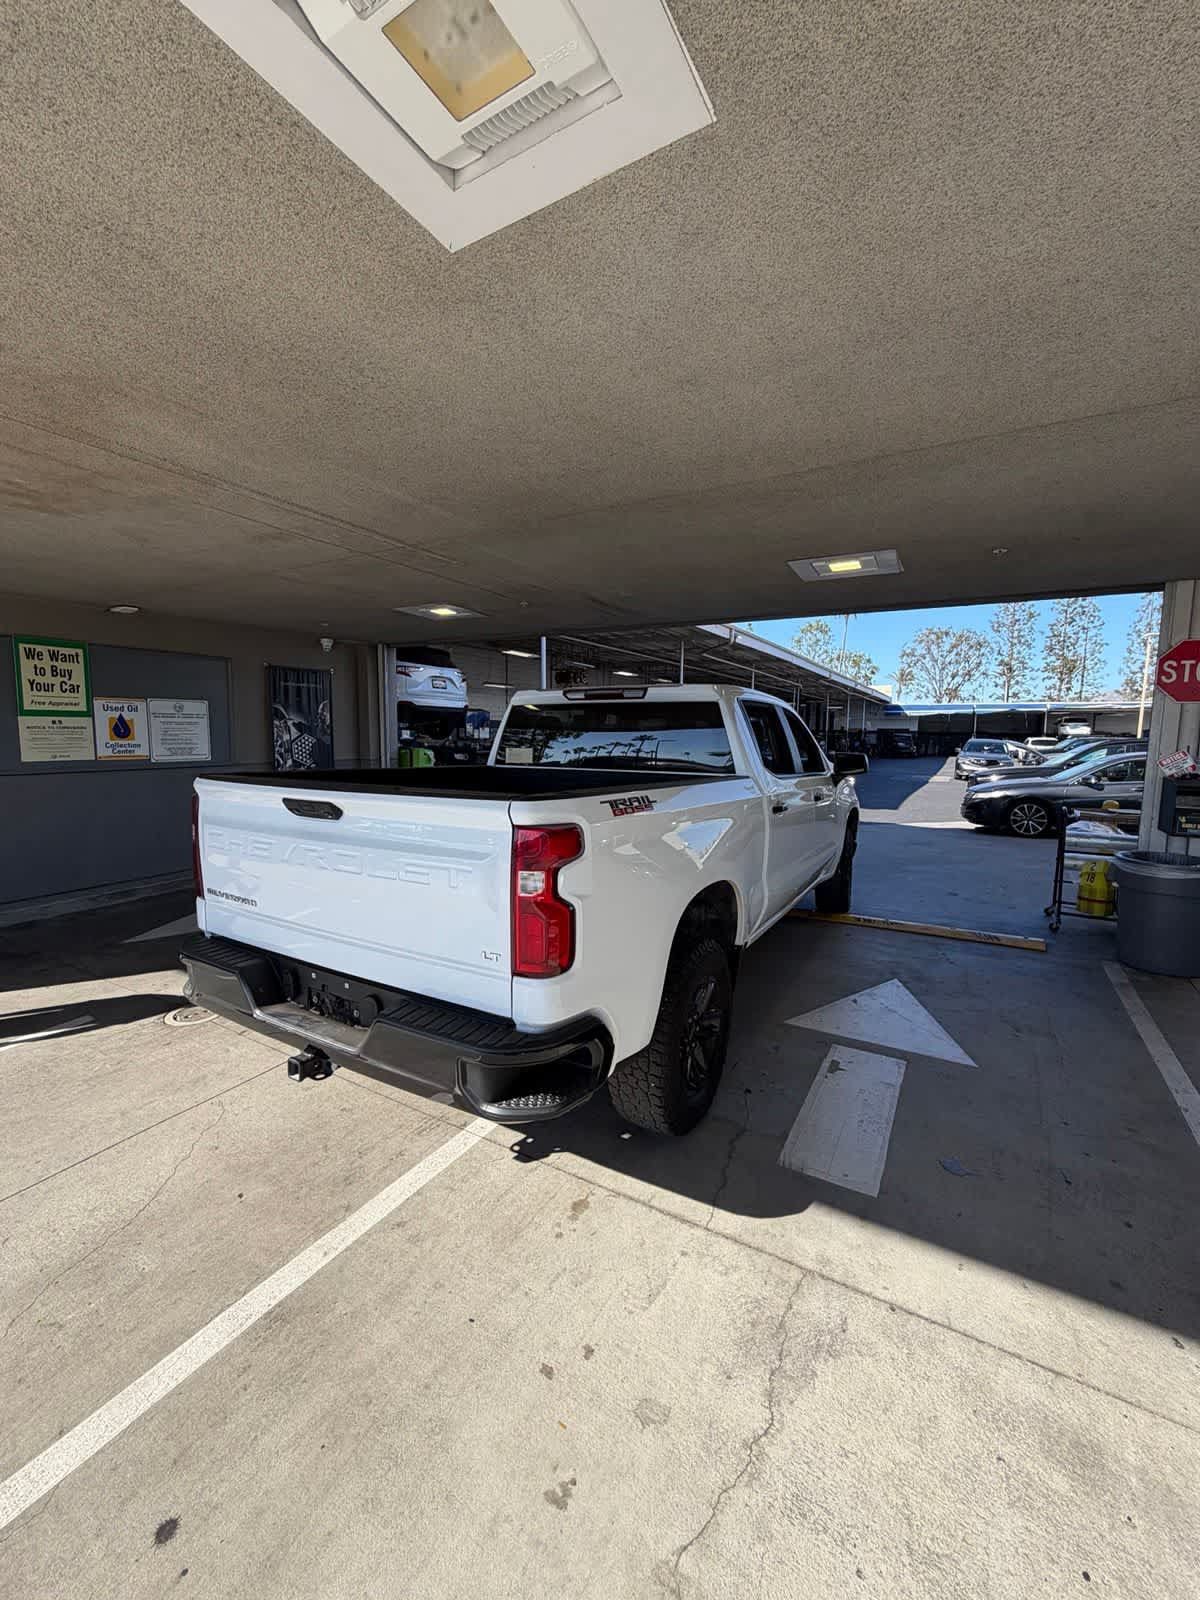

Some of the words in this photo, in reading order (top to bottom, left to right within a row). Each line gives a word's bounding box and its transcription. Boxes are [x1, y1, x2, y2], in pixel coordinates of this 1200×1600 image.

[23, 646, 44, 661] We
[47, 648, 80, 664] Want
[33, 663, 46, 676] to
[50, 665, 73, 681] Buy
[1161, 660, 1200, 684] ST
[27, 678, 56, 693] Your
[59, 681, 81, 694] Car
[102, 703, 125, 713] Used
[127, 705, 139, 713] Oil
[104, 742, 142, 750] Collection
[600, 795, 656, 809] TRAIL
[612, 805, 654, 817] BOSS
[206, 828, 474, 890] CHEVROLET
[481, 950, 502, 962] LT
